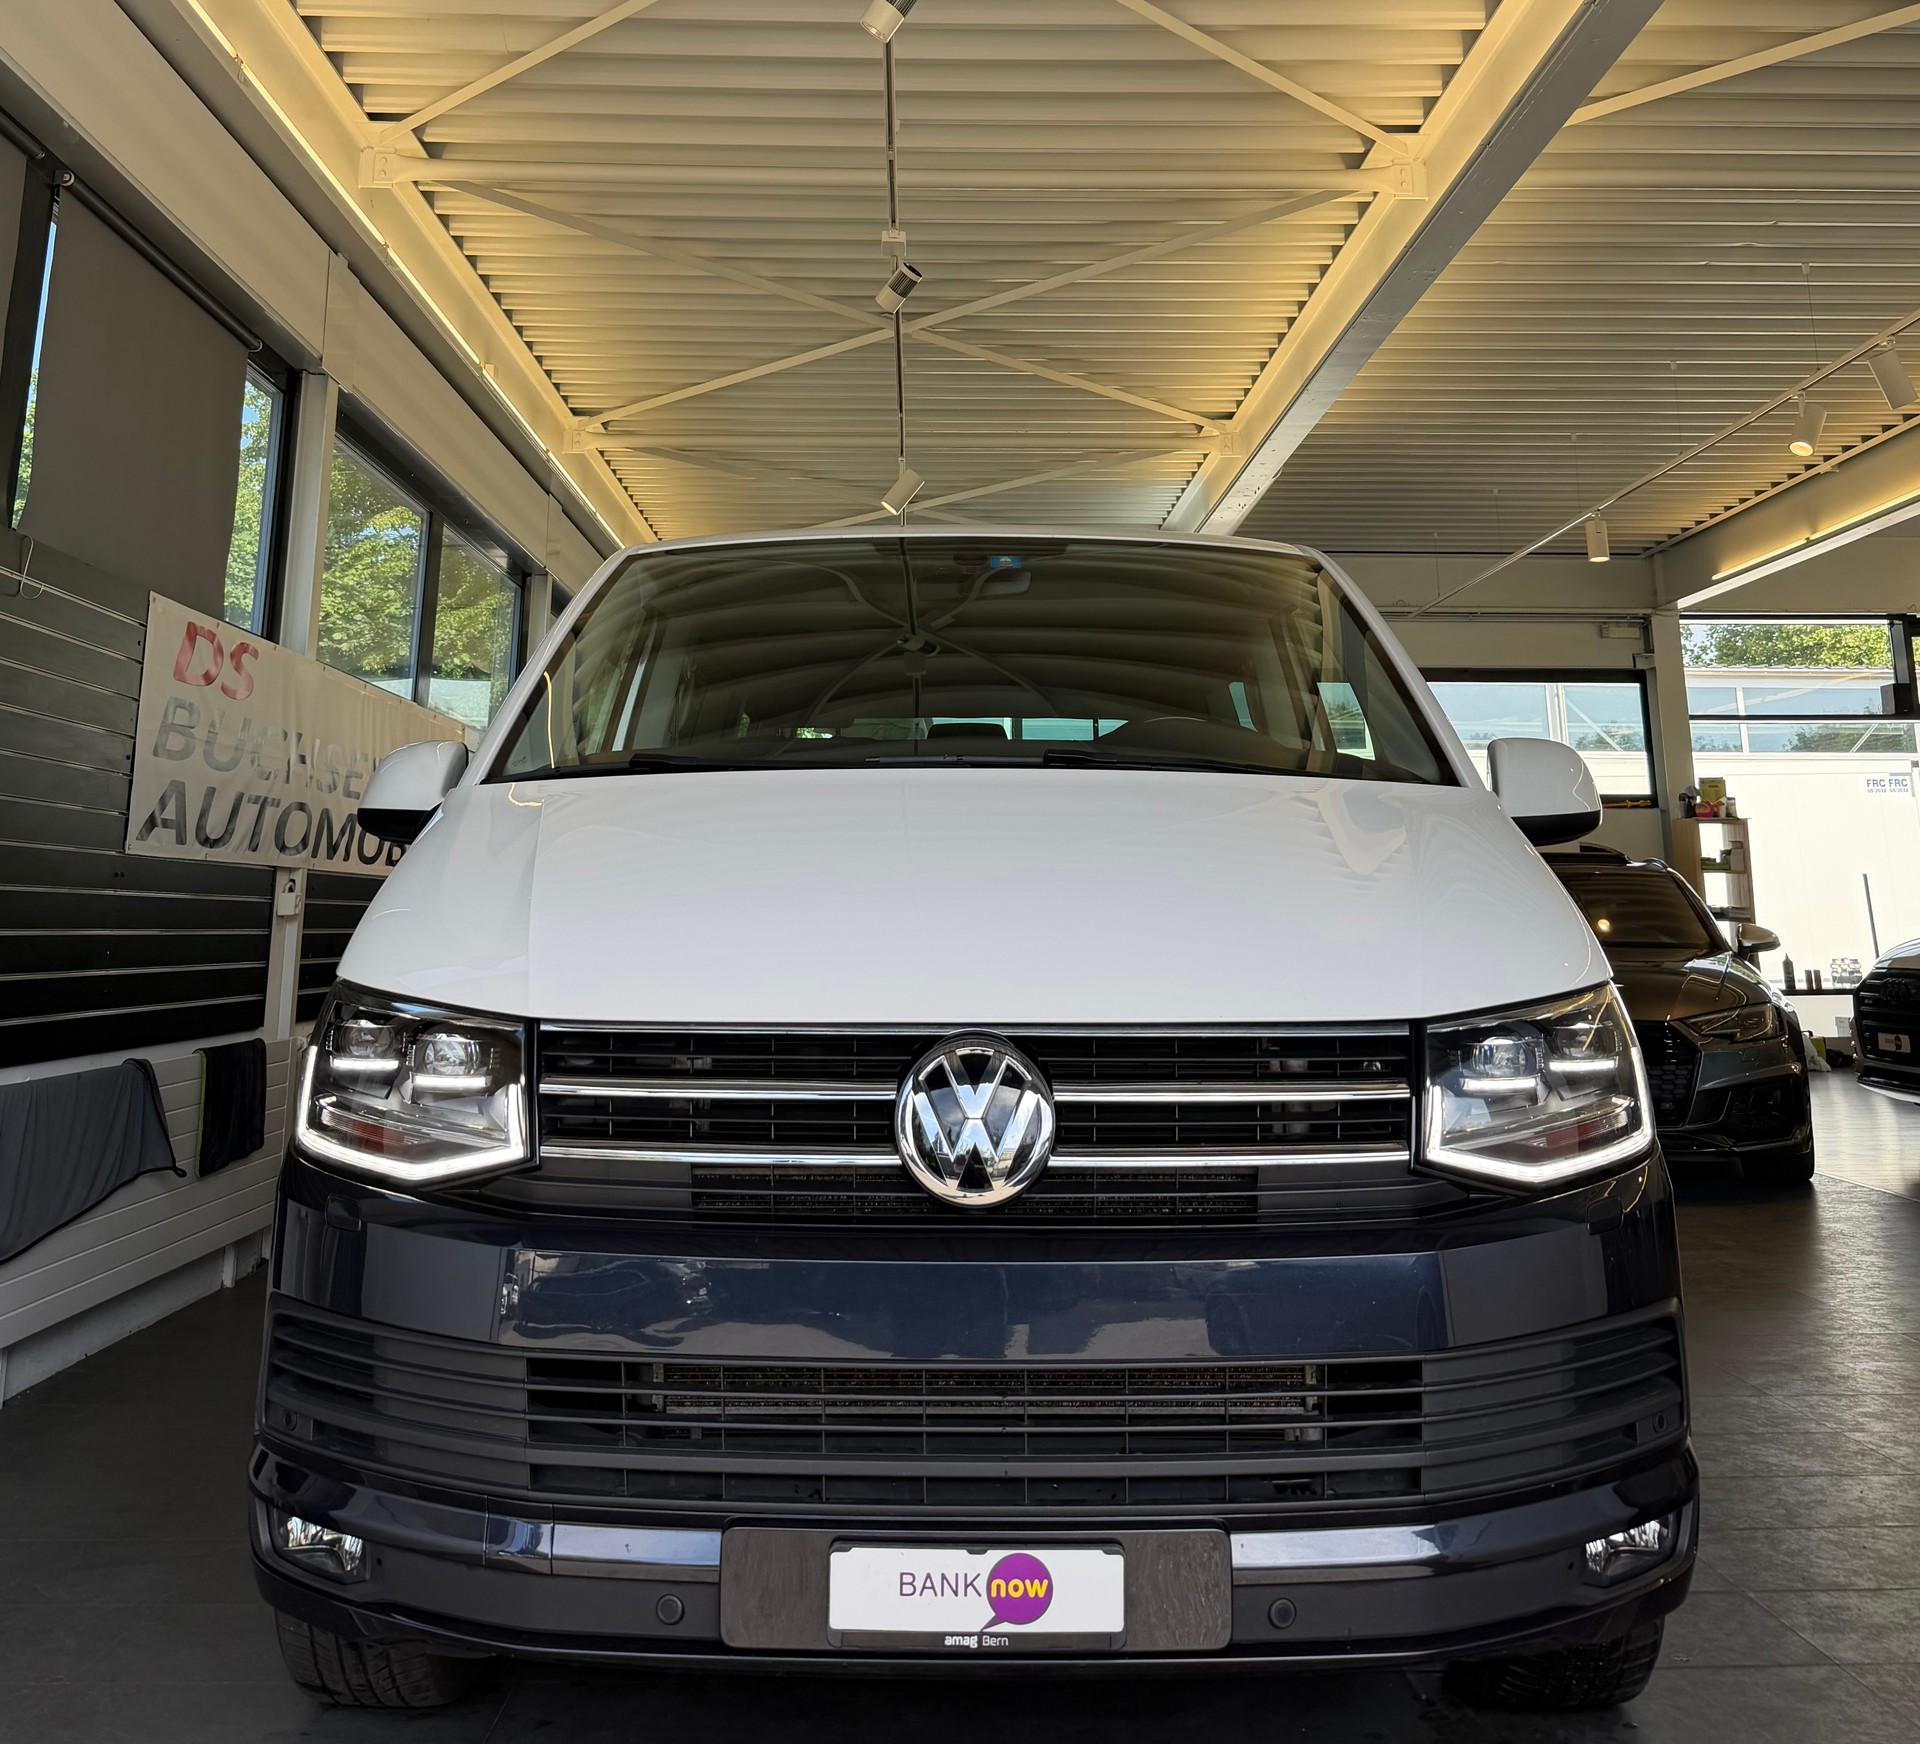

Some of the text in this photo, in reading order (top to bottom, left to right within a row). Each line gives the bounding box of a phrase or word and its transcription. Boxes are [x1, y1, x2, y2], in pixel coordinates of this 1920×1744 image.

[173, 621, 260, 700] DS
[152, 696, 382, 800] BUCHSE
[1866, 778, 1908, 788] FRC FRC
[899, 1572, 1049, 1599] BANK now
[944, 1635, 1009, 1648] amag Bern
